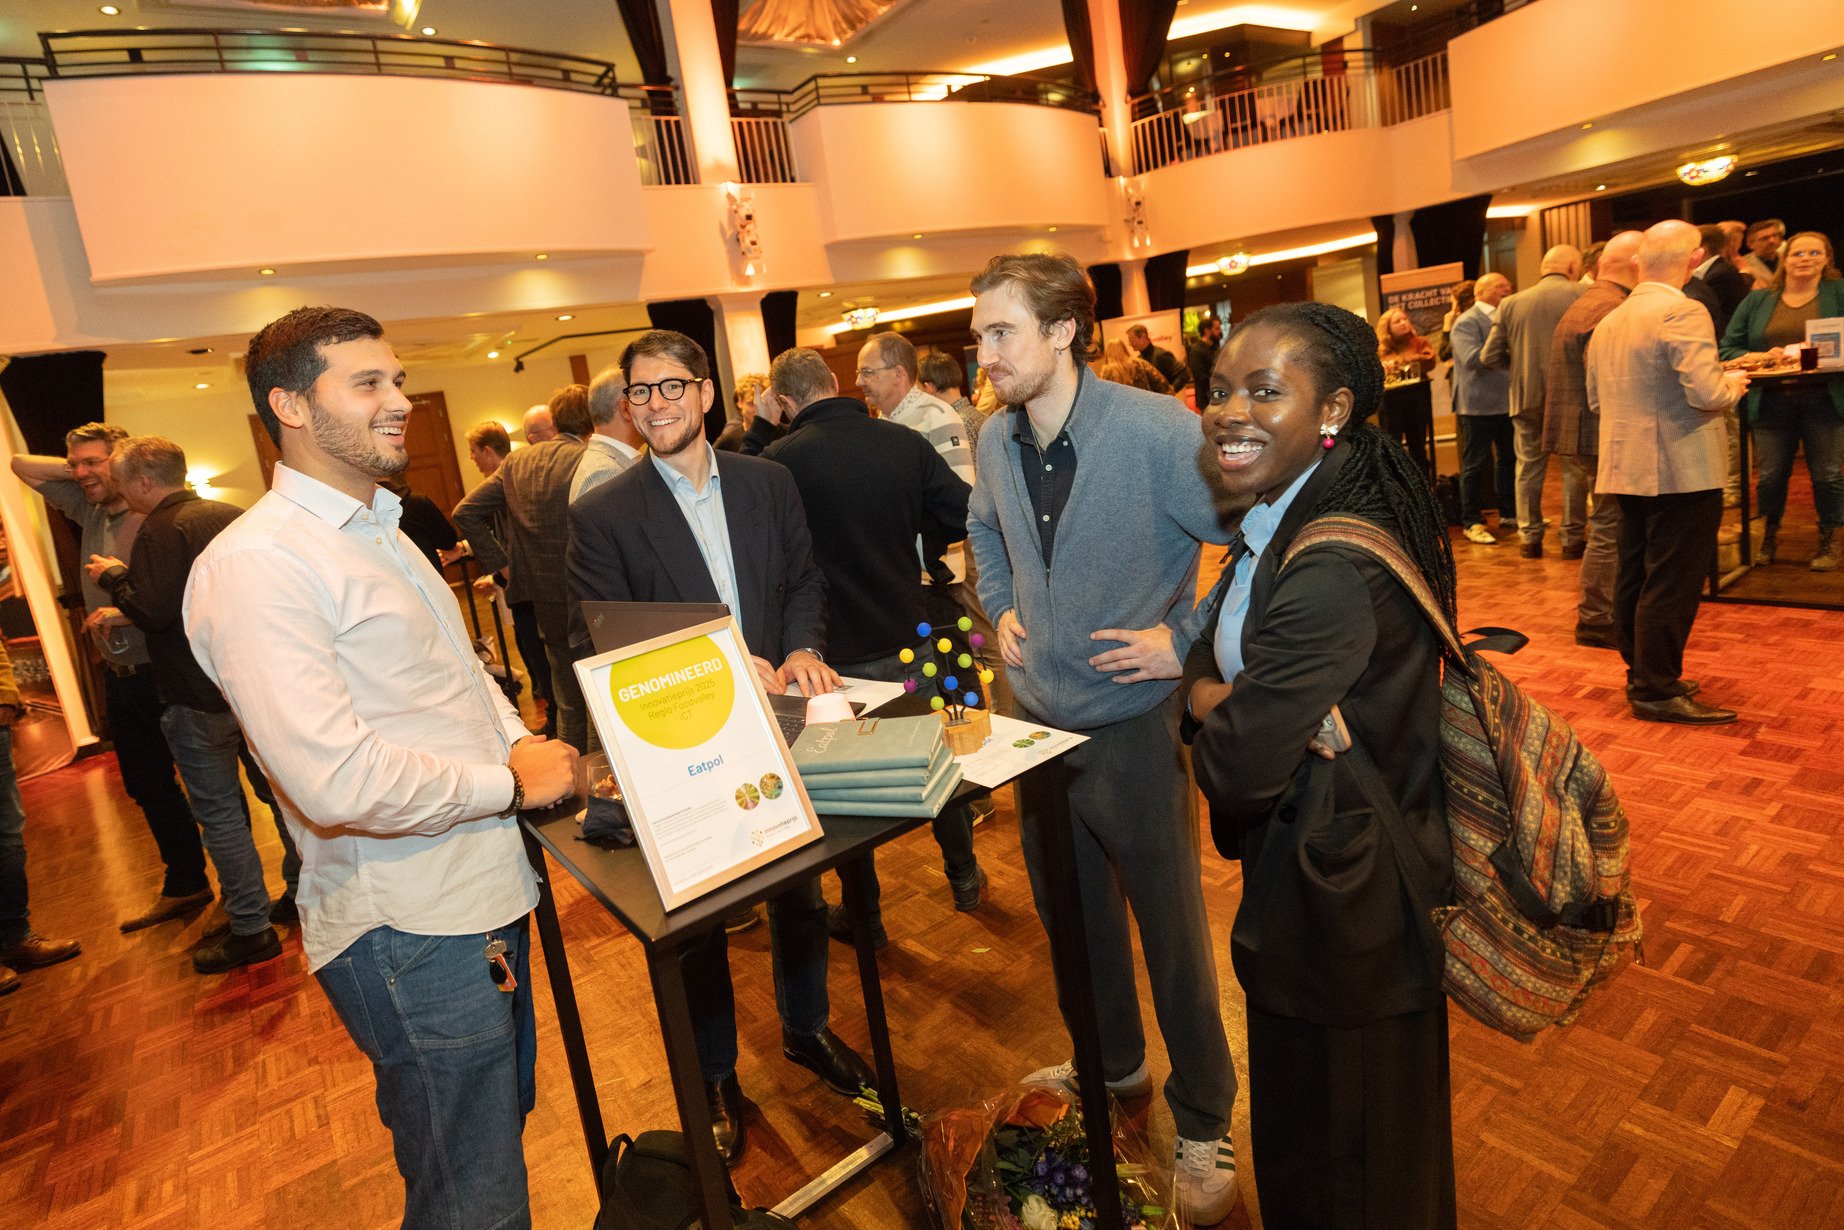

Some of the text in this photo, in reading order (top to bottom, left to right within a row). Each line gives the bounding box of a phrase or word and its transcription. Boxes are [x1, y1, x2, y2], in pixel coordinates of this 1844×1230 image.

[1388, 287, 1452, 304] DE KRACHT VA
[1407, 296, 1451, 310] COLLECTI
[618, 658, 723, 703] GENOMINEERD
[640, 679, 716, 712] Innovatieprijs 2025
[648, 692, 716, 721] Regio Foodvalley
[679, 710, 693, 721] ICT
[687, 754, 724, 777] Eatpol
